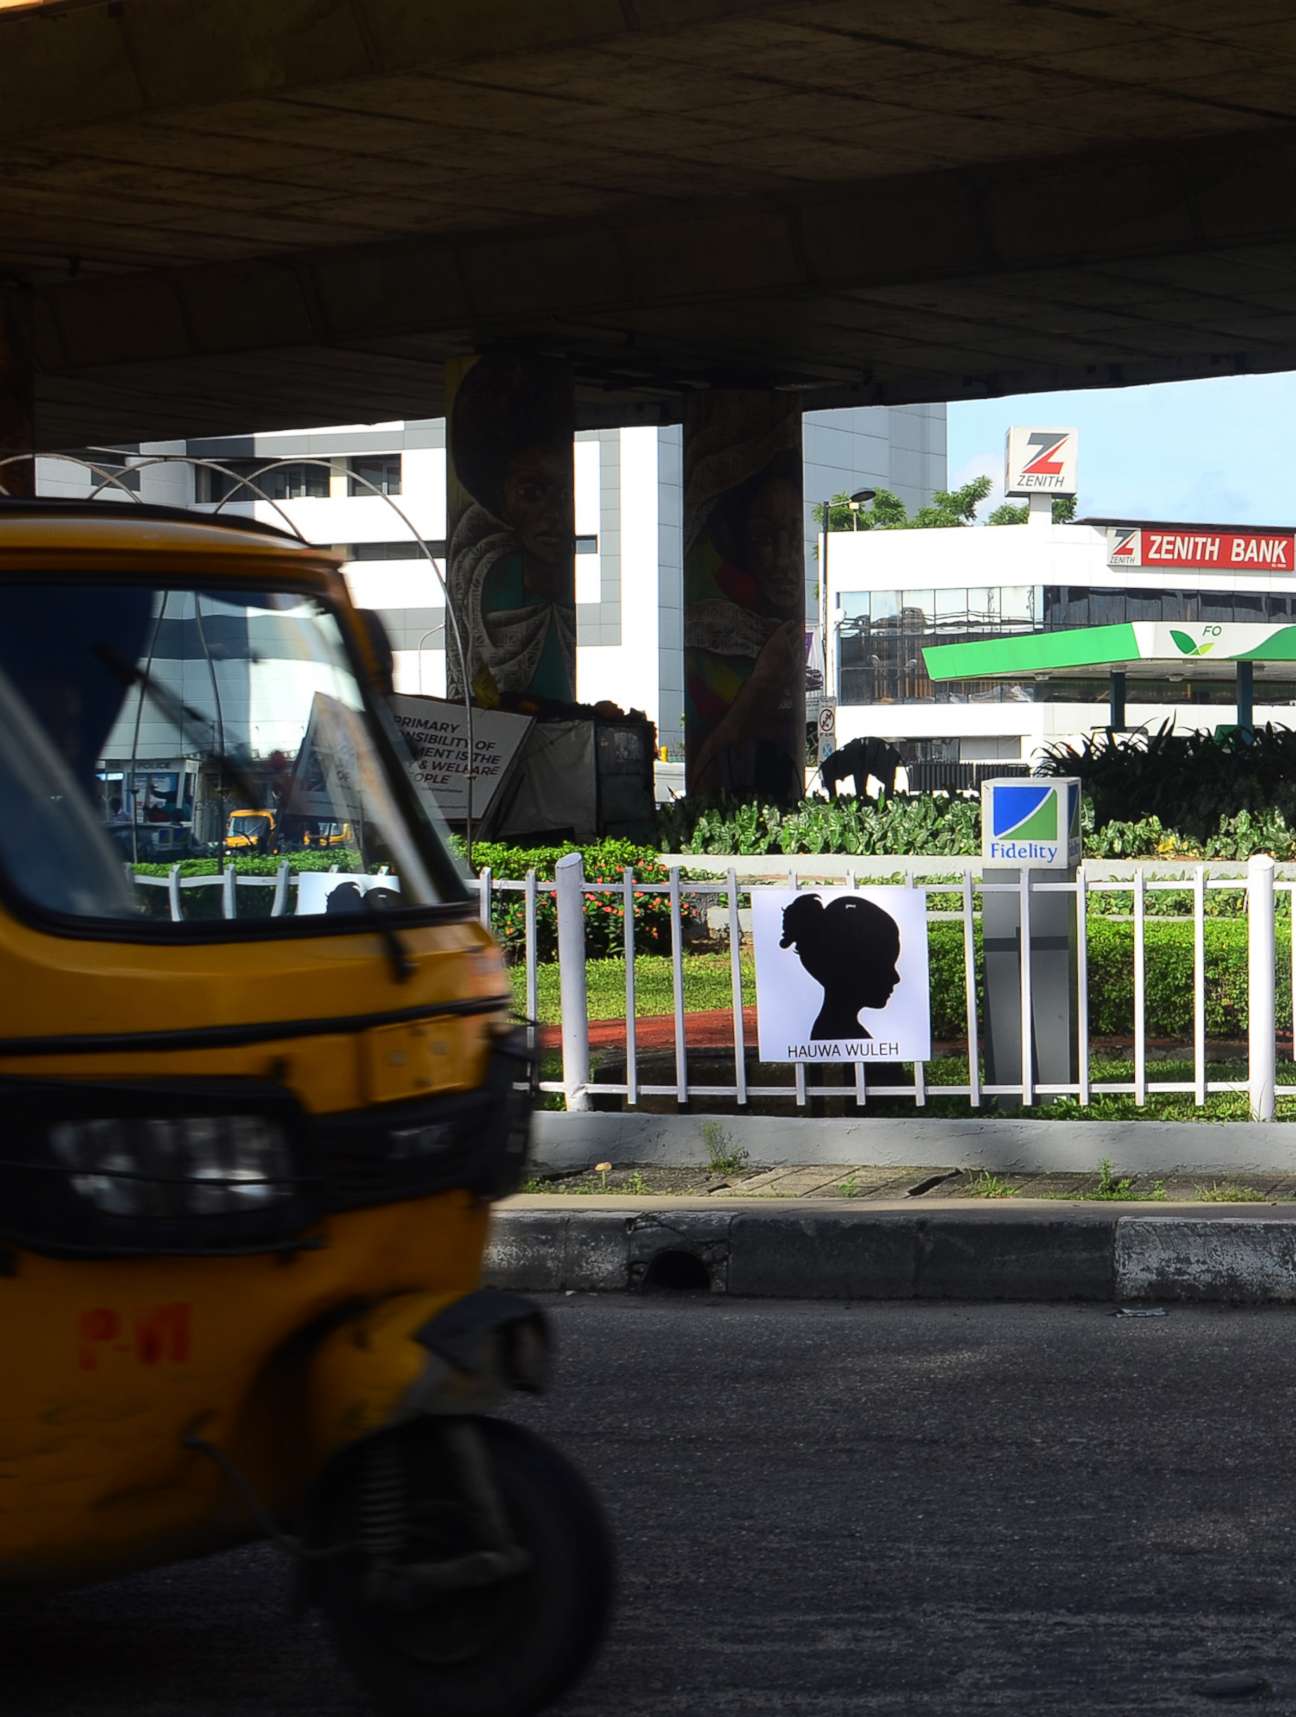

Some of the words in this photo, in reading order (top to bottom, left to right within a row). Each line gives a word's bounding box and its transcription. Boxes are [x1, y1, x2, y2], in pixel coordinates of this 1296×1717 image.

[1017, 474, 1065, 488] ZENITH
[1148, 536, 1222, 561] ZENITH
[1230, 539, 1289, 563] BANK
[1110, 555, 1135, 564] ZENITH
[1202, 625, 1223, 637] FO
[475, 740, 496, 751] OF
[472, 752, 502, 764] THE
[991, 842, 1058, 863] Fidelity
[787, 1044, 842, 1058] HAUWA
[845, 1042, 900, 1057] WULEH
